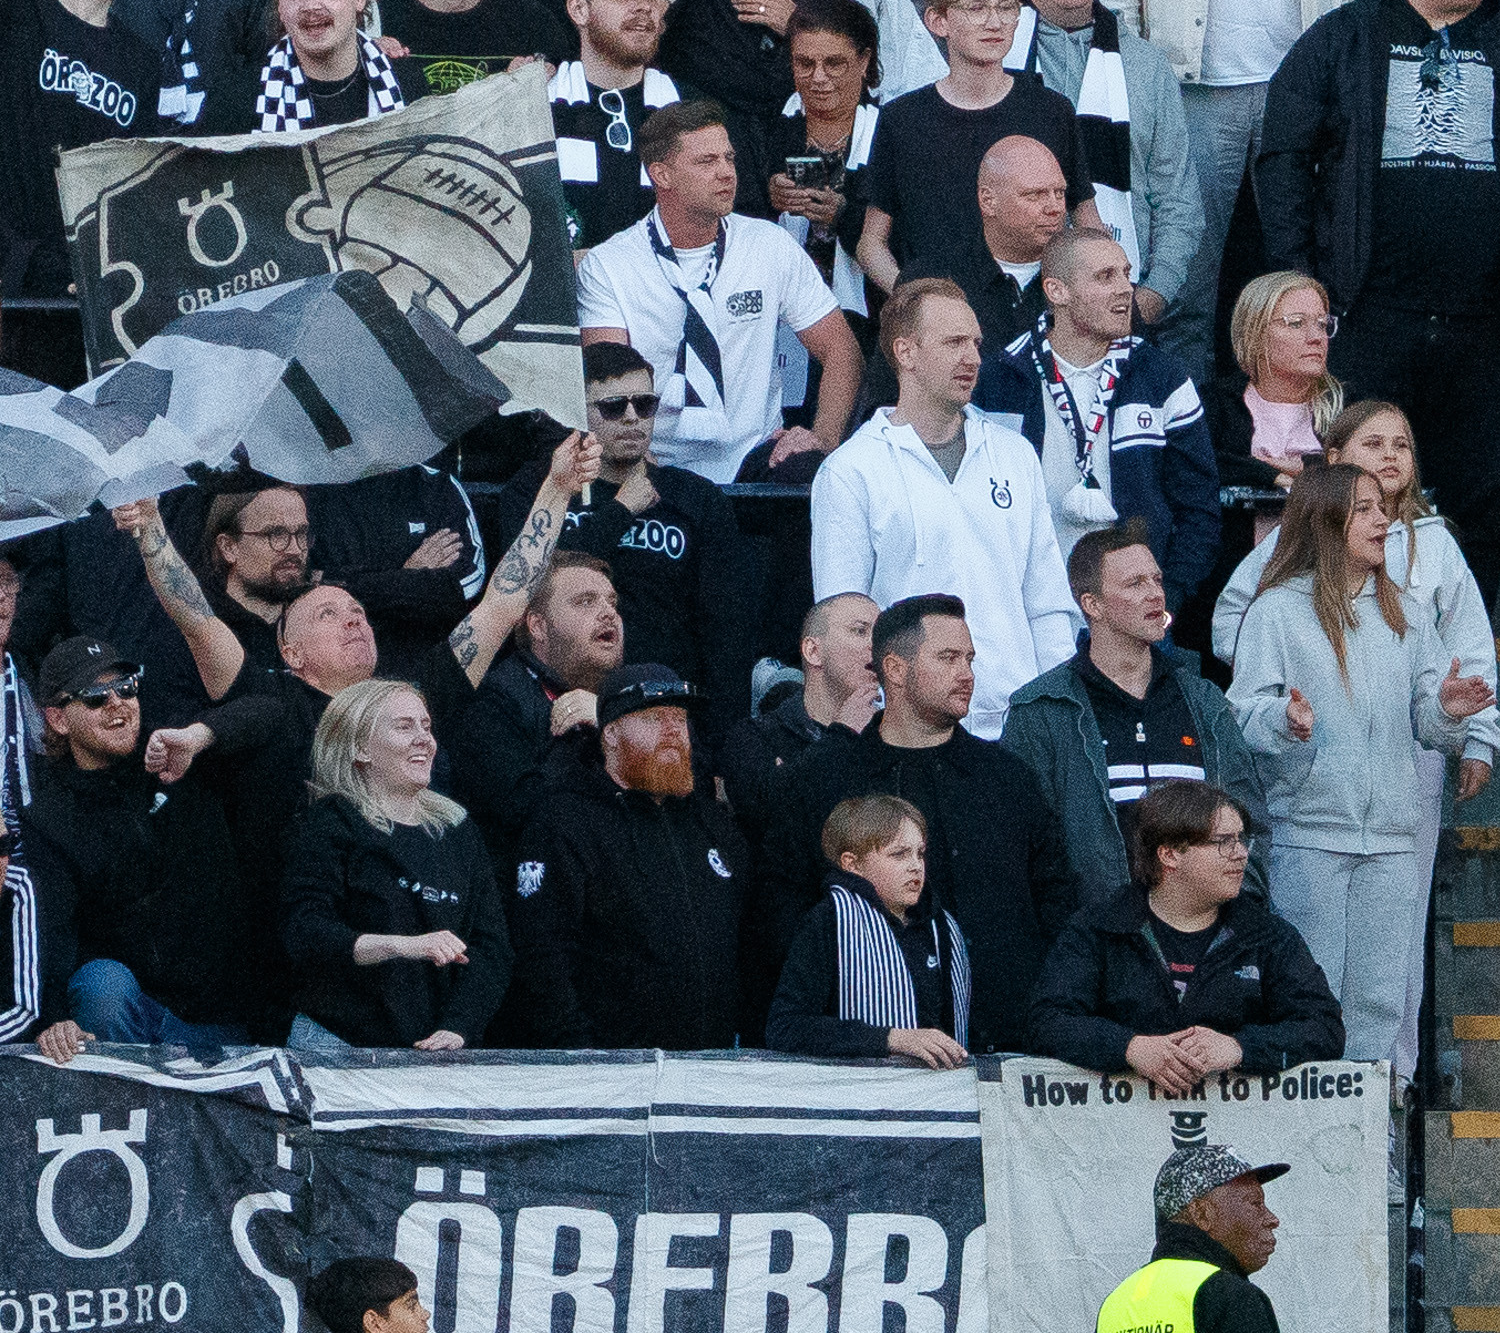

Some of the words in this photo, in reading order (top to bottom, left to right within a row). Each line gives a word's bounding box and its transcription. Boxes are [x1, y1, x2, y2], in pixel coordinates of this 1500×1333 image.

[176, 260, 281, 316] ÖREBRO
[1022, 1074, 1089, 1108] How
[1100, 1074, 1134, 1106] to
[1261, 1068, 1364, 1101] Police:
[393, 1167, 988, 1333] ÖREBR
